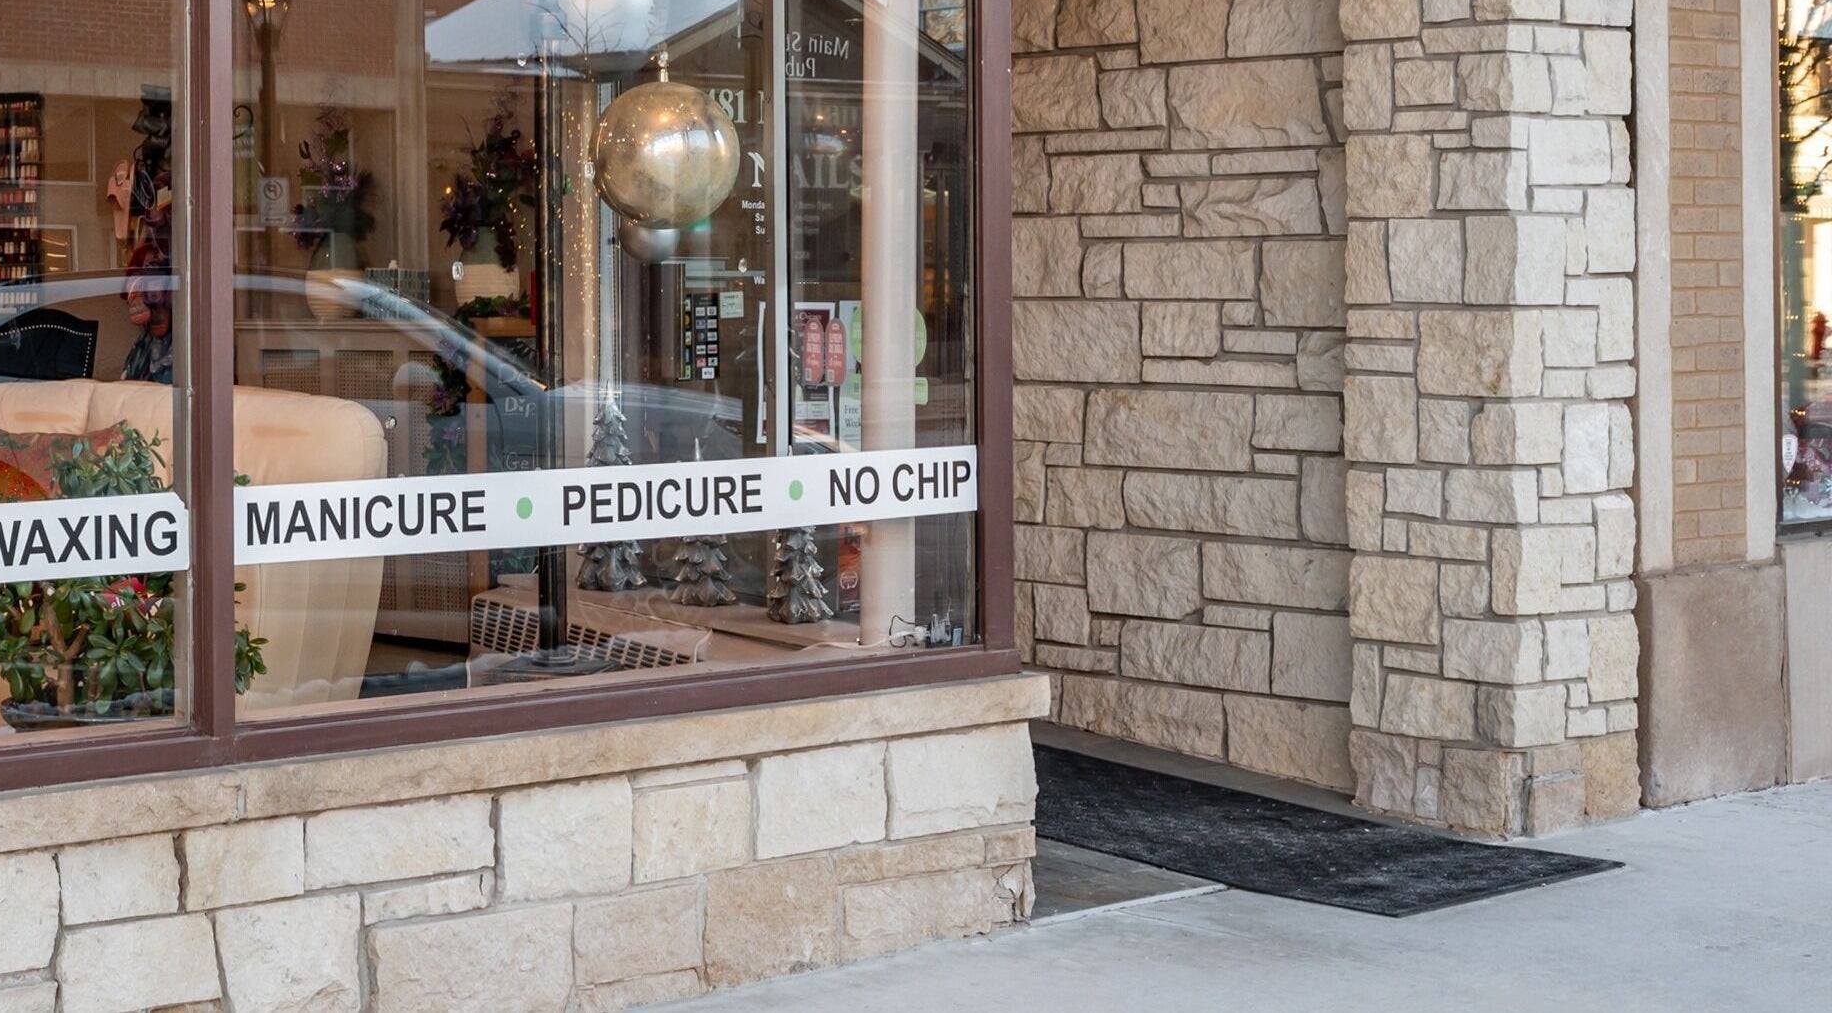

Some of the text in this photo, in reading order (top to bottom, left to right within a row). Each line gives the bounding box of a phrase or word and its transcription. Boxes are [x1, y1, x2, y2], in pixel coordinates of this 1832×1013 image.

[708, 88, 748, 124] 81
[245, 459, 972, 546] MANICURE PEDICURE NO CHIP
